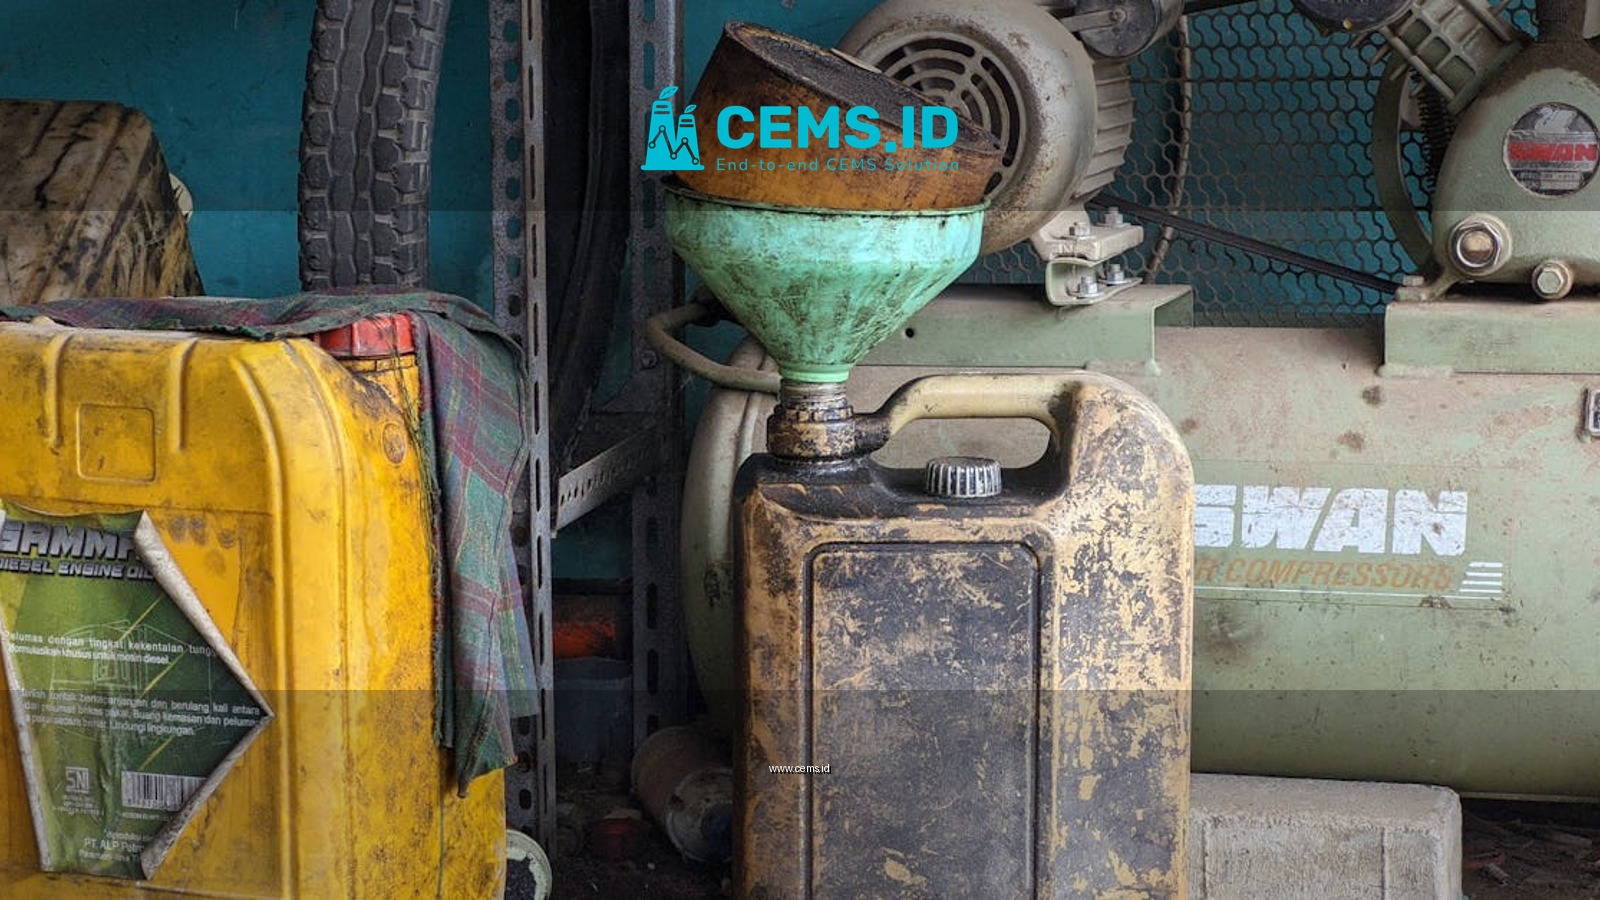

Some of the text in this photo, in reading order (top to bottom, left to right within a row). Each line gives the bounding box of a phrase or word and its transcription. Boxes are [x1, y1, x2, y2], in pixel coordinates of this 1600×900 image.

[1194, 484, 1468, 556] SWAN
[58, 560, 123, 579] ENGINE
[1224, 558, 1455, 591] COMPRESSORS
